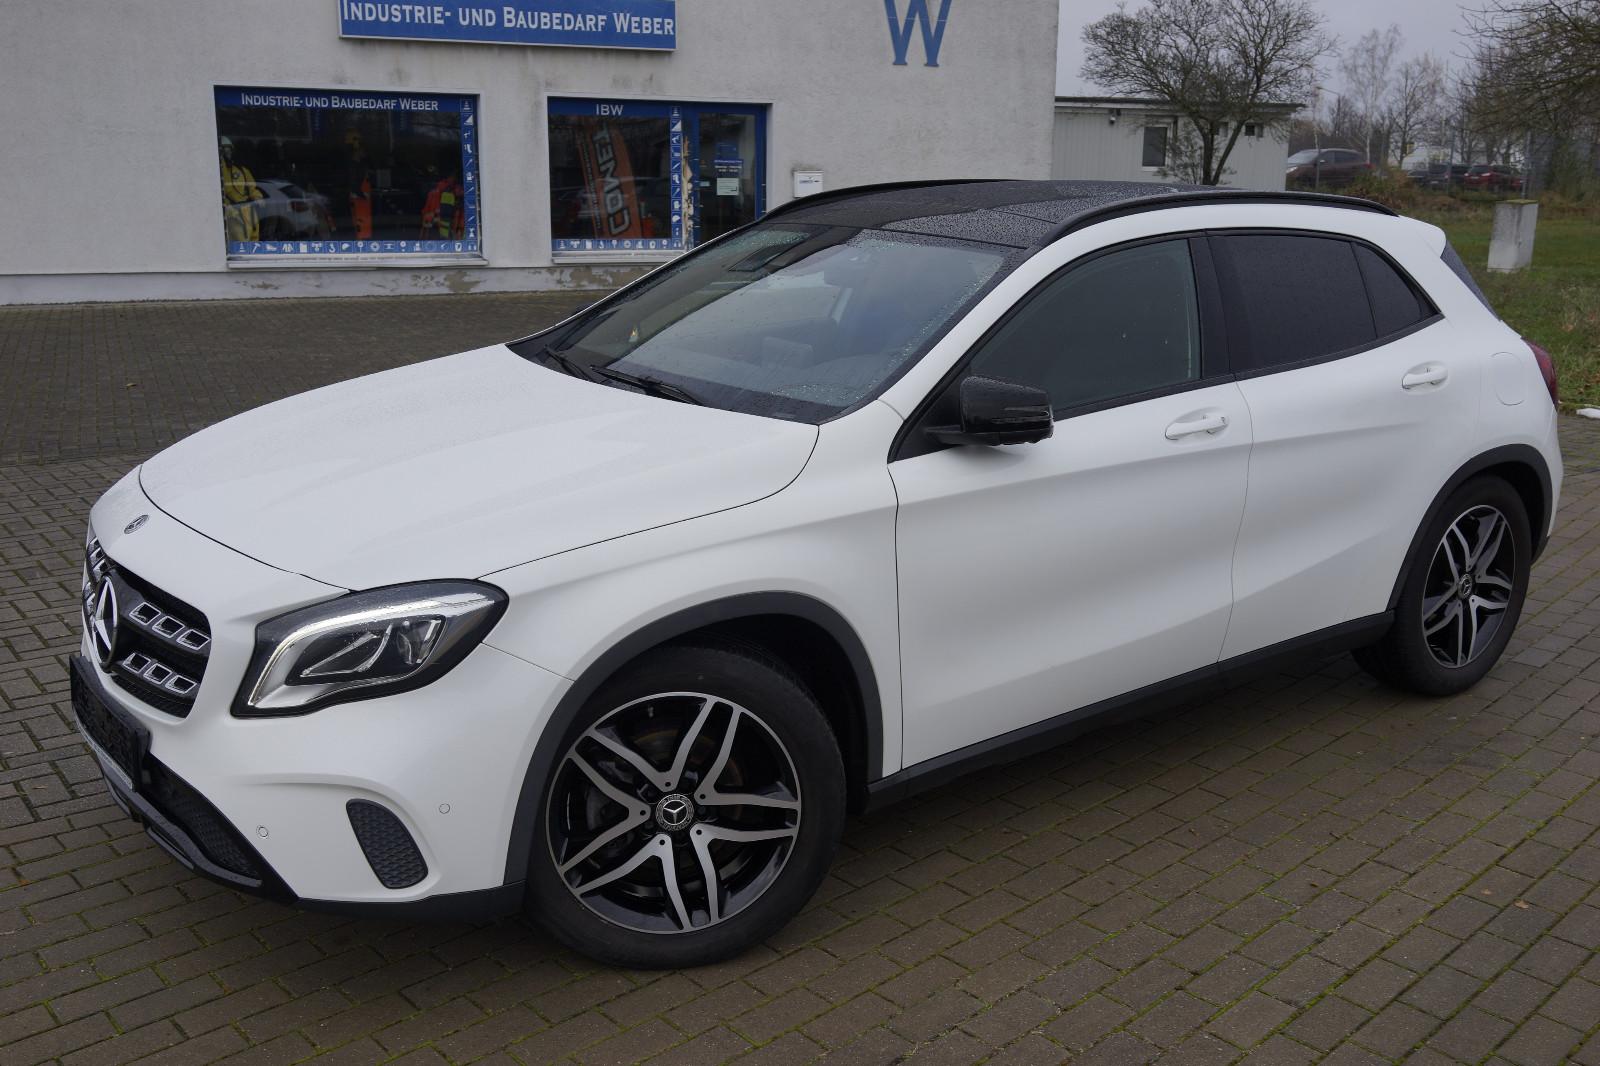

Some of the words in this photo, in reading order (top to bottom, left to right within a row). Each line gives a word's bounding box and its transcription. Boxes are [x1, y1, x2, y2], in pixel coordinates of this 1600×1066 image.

[341, 0, 451, 25] INDUSTRIE-
[458, 8, 496, 27] UND
[503, 6, 608, 32] BAUBEDARF
[612, 12, 675, 36] WEBER
[884, 0, 953, 67] W
[241, 93, 303, 107] INDUSTRIE-
[305, 97, 329, 108] UND
[331, 96, 398, 110] BAUBEDARF
[399, 98, 439, 111] WEBER
[595, 104, 624, 116] IBW
